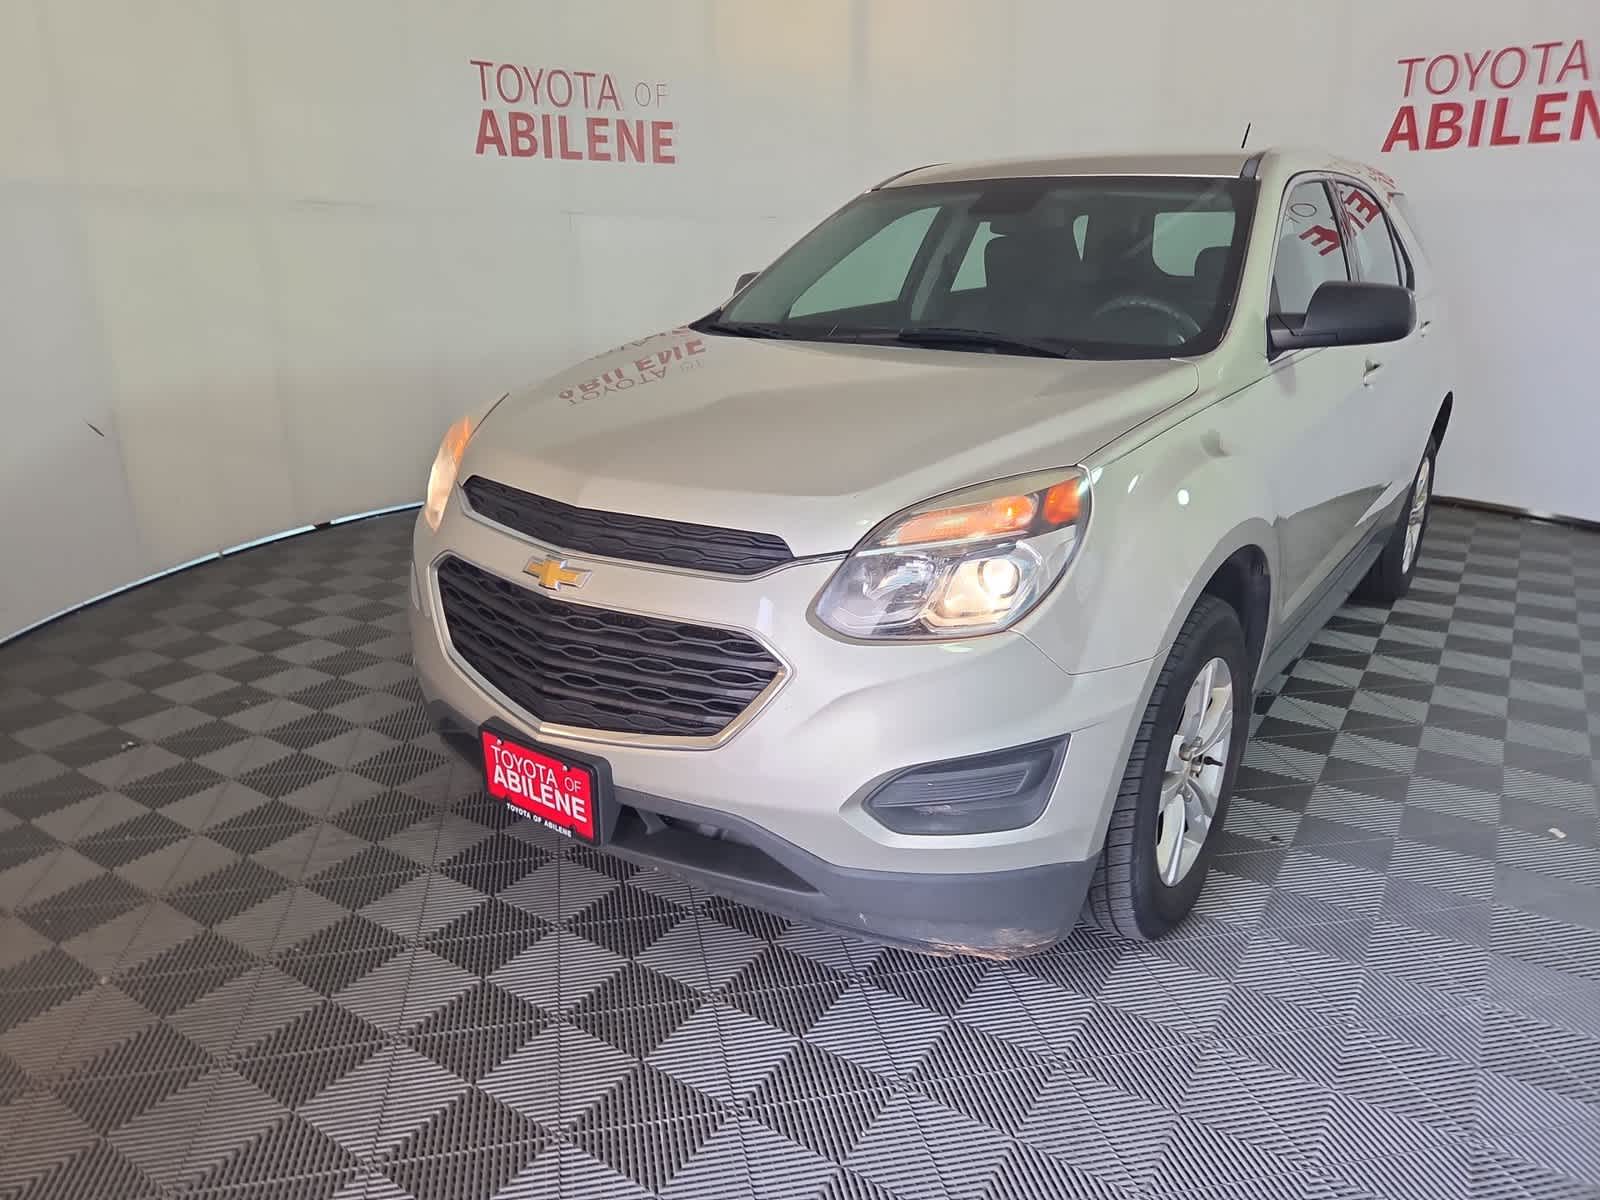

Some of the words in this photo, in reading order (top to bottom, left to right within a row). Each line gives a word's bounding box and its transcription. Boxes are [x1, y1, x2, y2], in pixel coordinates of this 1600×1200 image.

[470, 60, 623, 111] TOYOTA
[634, 82, 669, 108] OF
[1397, 39, 1590, 98] TOYOTA
[475, 109, 676, 164] ABILENE
[490, 744, 559, 789] TOYOTA
[564, 776, 582, 793] OF
[493, 764, 588, 823] ABILENE
[506, 802, 532, 819] TOYOTA
[532, 814, 542, 823] OF
[543, 820, 572, 838] ABILENE
